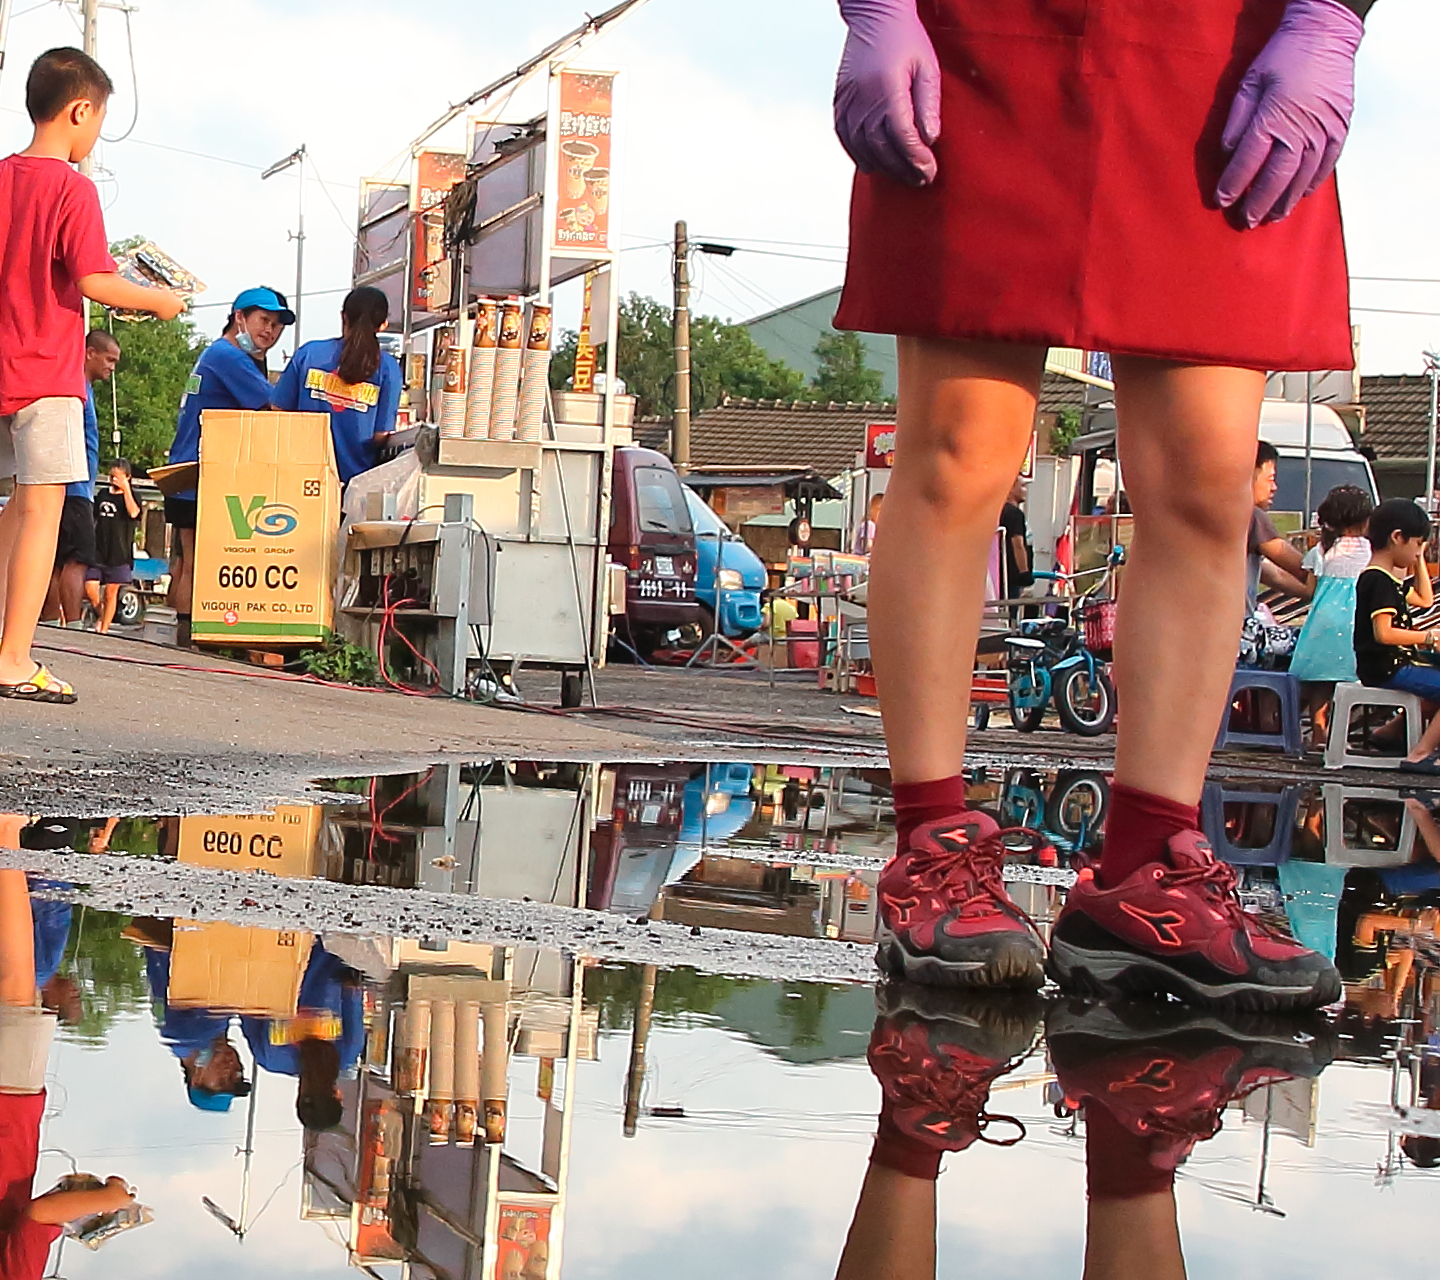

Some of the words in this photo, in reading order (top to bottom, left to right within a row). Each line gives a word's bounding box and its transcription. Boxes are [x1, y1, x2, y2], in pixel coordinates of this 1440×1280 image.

[219, 564, 258, 589] 660
[265, 564, 299, 590] CC
[201, 601, 241, 612] VIGOUR
[246, 602, 267, 613] PAK
